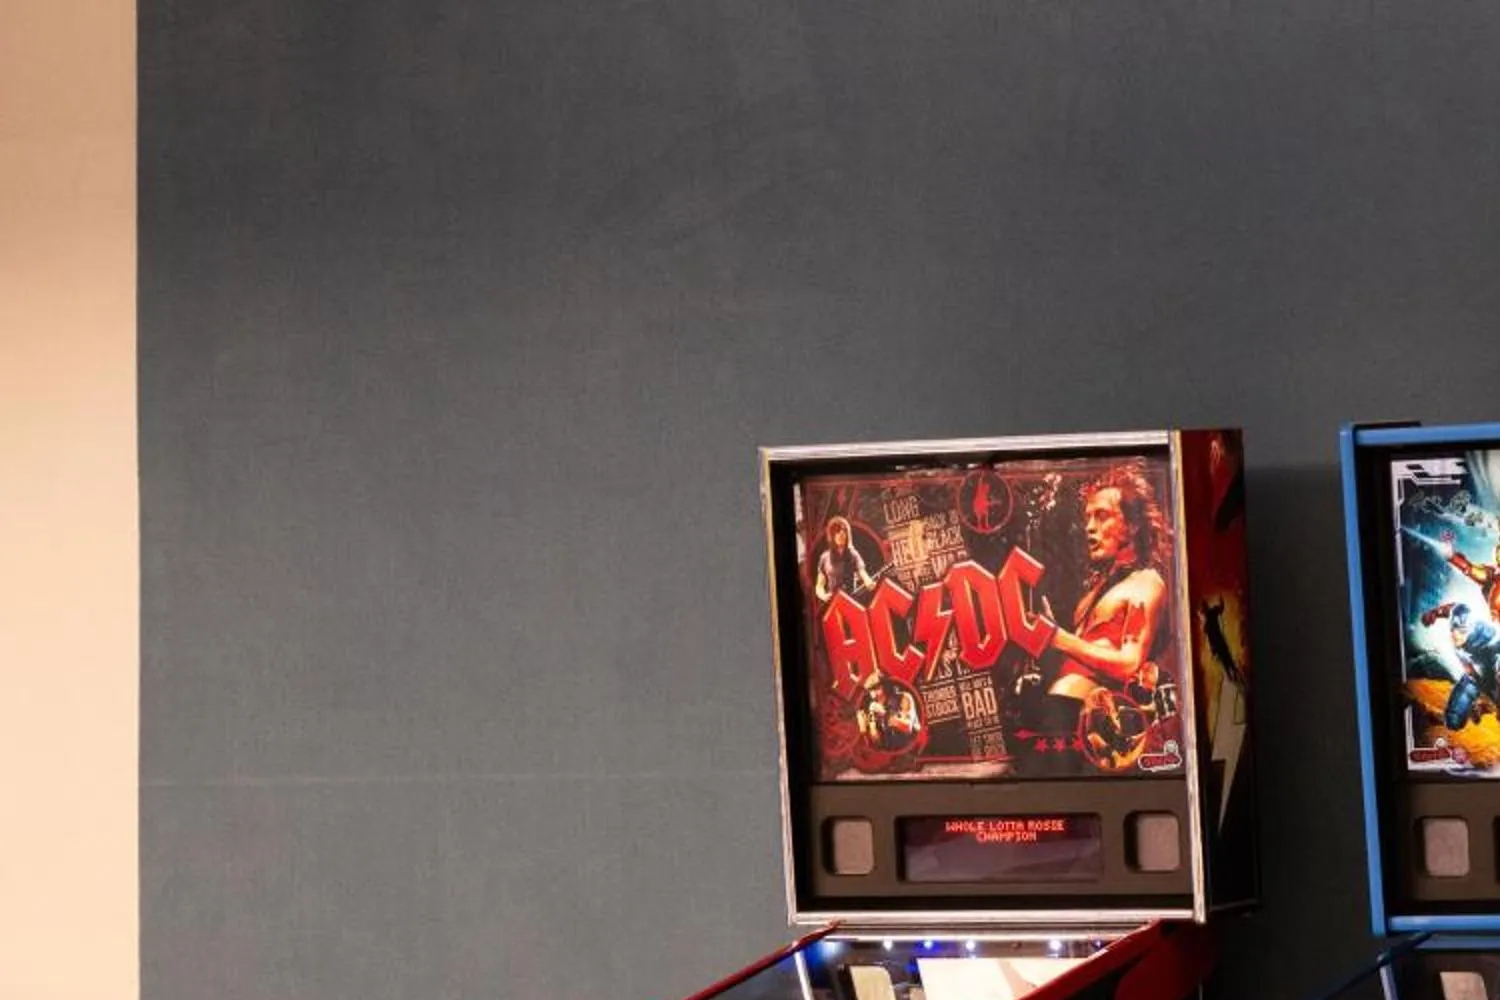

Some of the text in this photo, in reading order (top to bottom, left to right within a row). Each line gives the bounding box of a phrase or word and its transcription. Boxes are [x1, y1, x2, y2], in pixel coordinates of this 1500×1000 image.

[961, 687, 998, 720] BAD
[946, 820, 1064, 832] WHOLE LOTTA ROSIE
[976, 832, 1036, 842] CHAMPION
